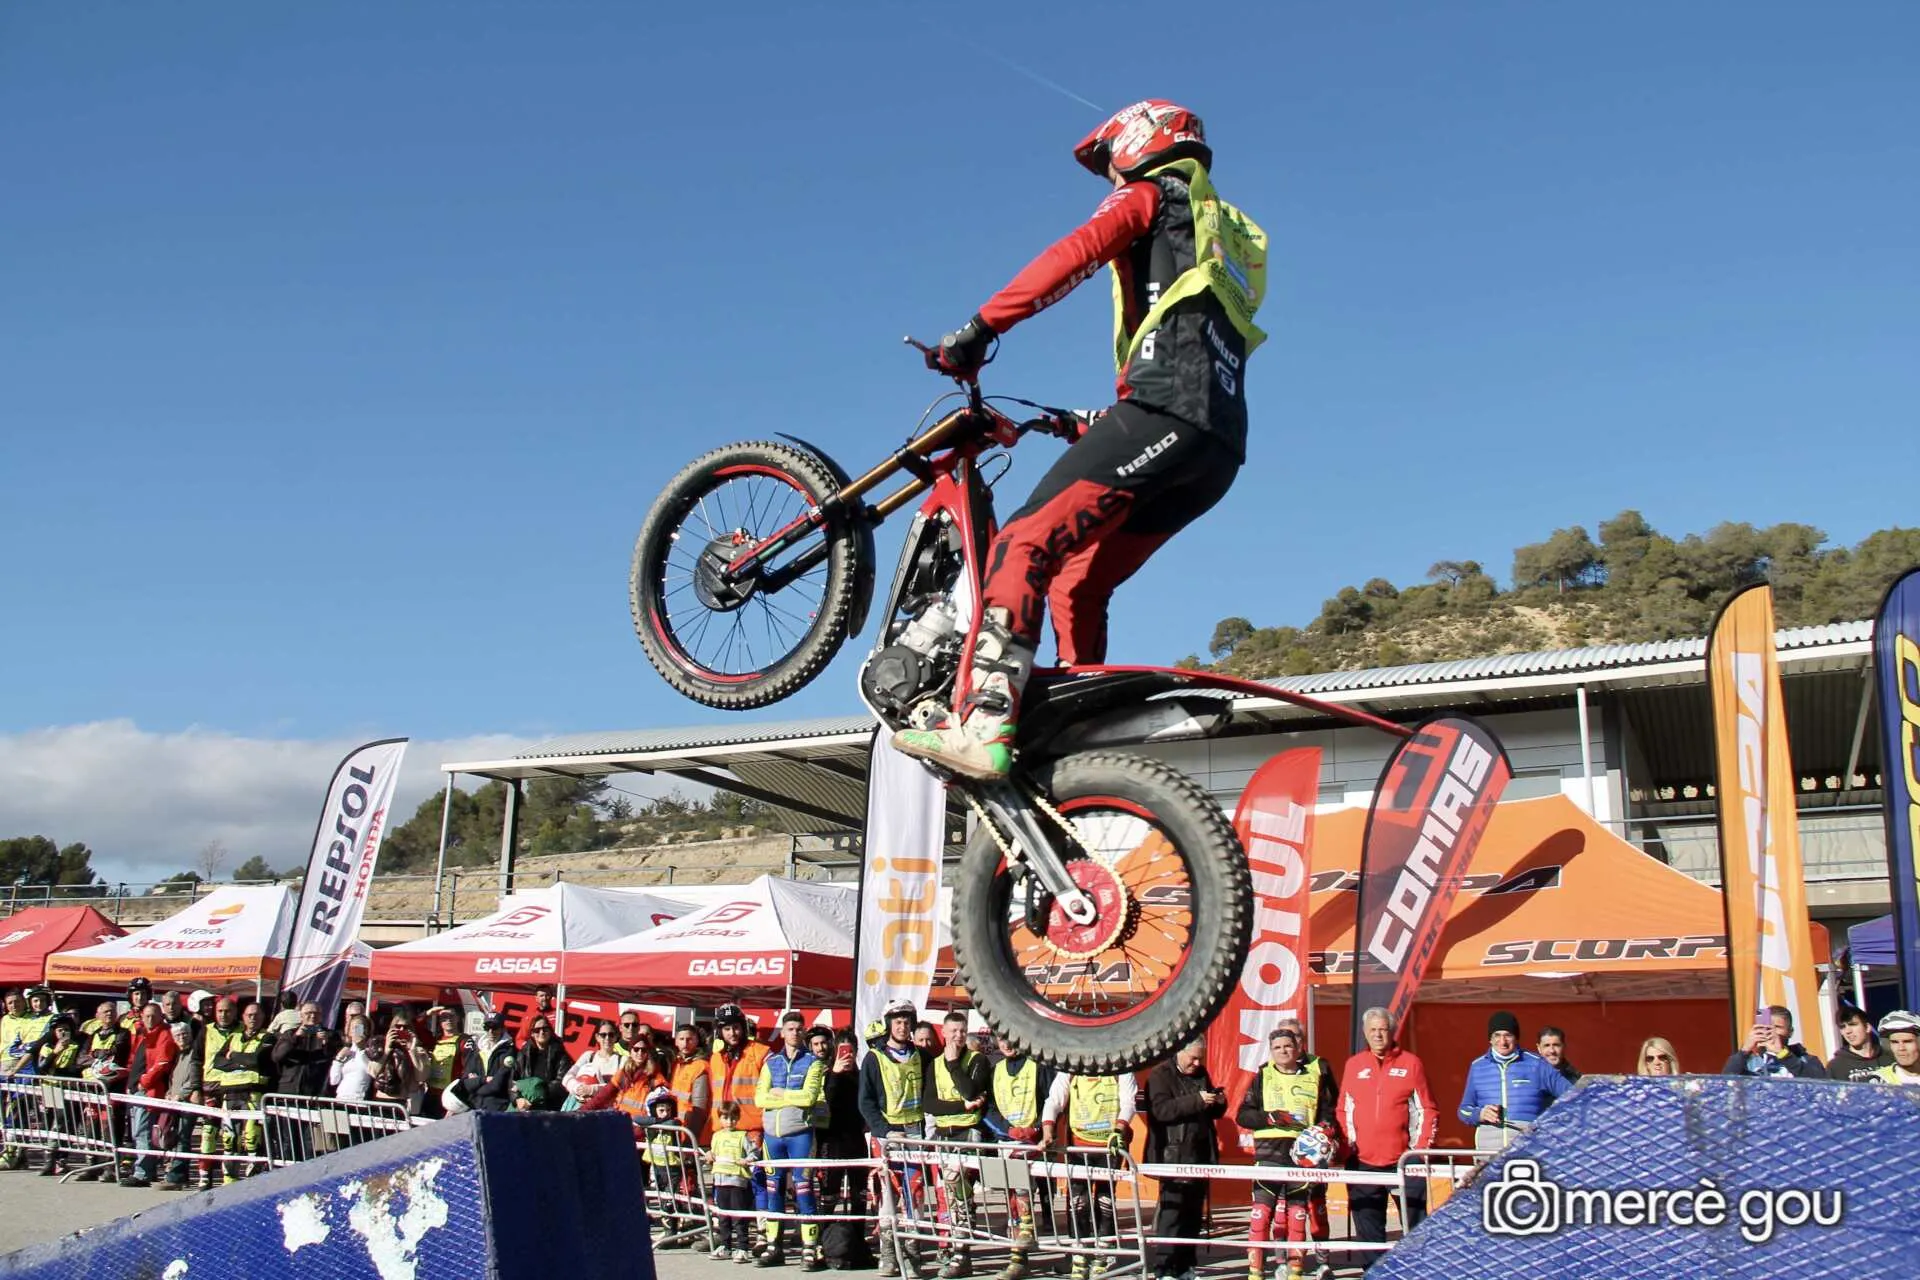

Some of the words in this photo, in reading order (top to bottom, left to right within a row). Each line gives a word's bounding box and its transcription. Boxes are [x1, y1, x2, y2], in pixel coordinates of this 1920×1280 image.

[1116, 431, 1179, 478] hebo
[310, 764, 375, 936] REPSOL
[353, 807, 385, 899] HONDA
[1368, 733, 1492, 973] COMAS
[864, 856, 937, 986] iati
[1238, 800, 1306, 1074] MOTUL
[129, 938, 225, 950] HONDA
[1482, 936, 1727, 967] SCORP
[191, 965, 226, 974] Honda
[227, 964, 258, 974] Team
[475, 957, 558, 974] GASGAS
[687, 957, 786, 976] GASGAS
[1389, 1067, 1408, 1078] 93
